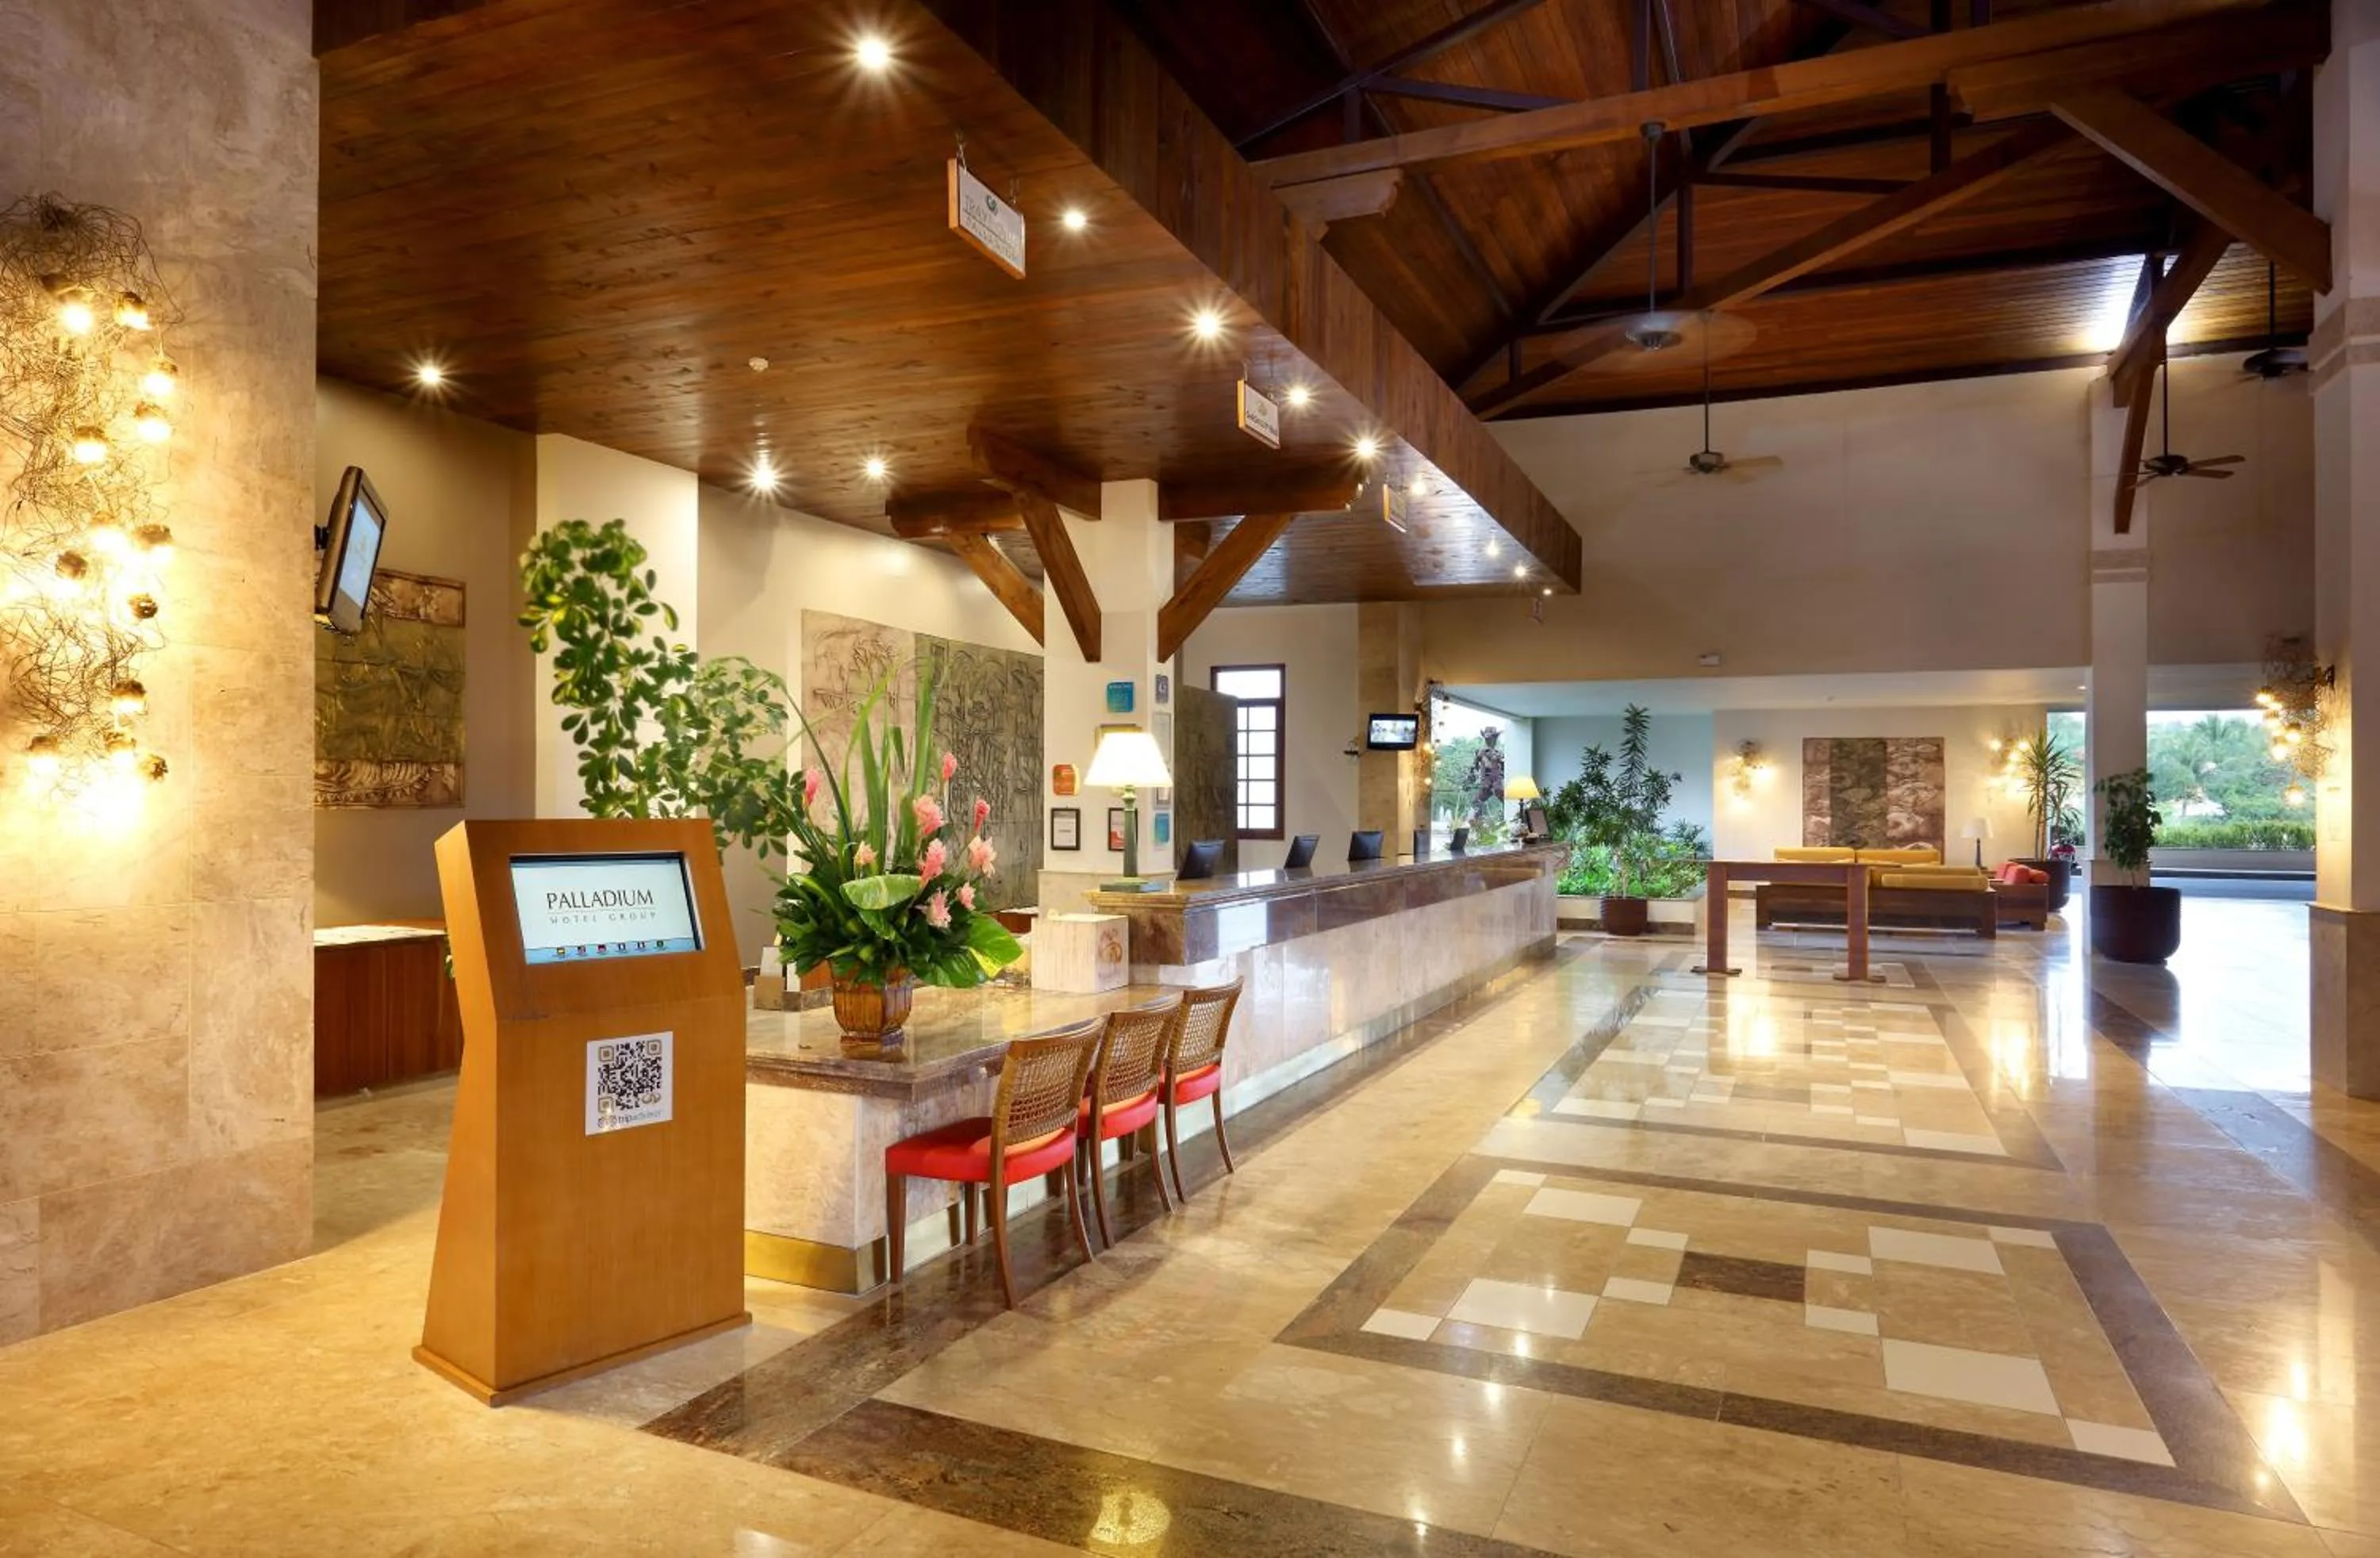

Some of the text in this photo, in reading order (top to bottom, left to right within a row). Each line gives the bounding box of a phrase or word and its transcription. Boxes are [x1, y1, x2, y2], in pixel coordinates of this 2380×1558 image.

[547, 889, 654, 909] PALLADIUM
[550, 911, 656, 924] HOTEL GROUP
